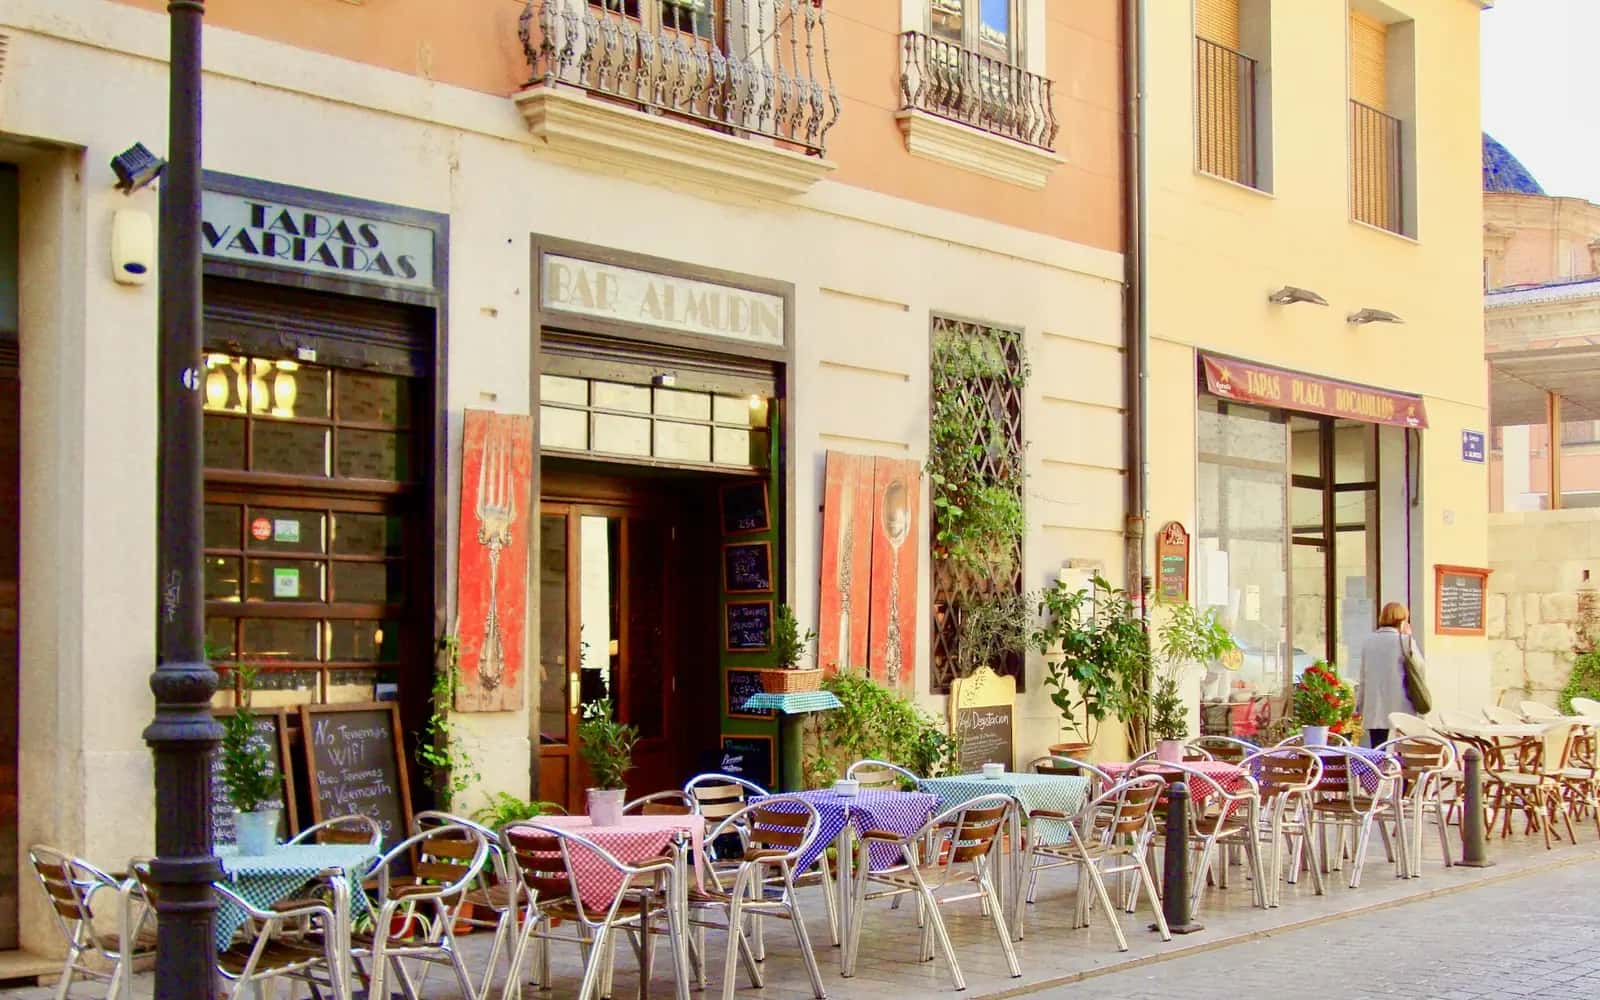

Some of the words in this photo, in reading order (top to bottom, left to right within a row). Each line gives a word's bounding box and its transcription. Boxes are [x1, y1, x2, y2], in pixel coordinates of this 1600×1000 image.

[202, 221, 417, 279] VARIADAS
[244, 201, 379, 248] TAPAS
[548, 262, 618, 312] BAR
[639, 281, 784, 339] ALMUDIN
[1245, 369, 1281, 401] TAPAS
[1291, 379, 1326, 409] PLAZA
[1335, 388, 1395, 421] BOCADILLOS
[314, 719, 334, 745] No
